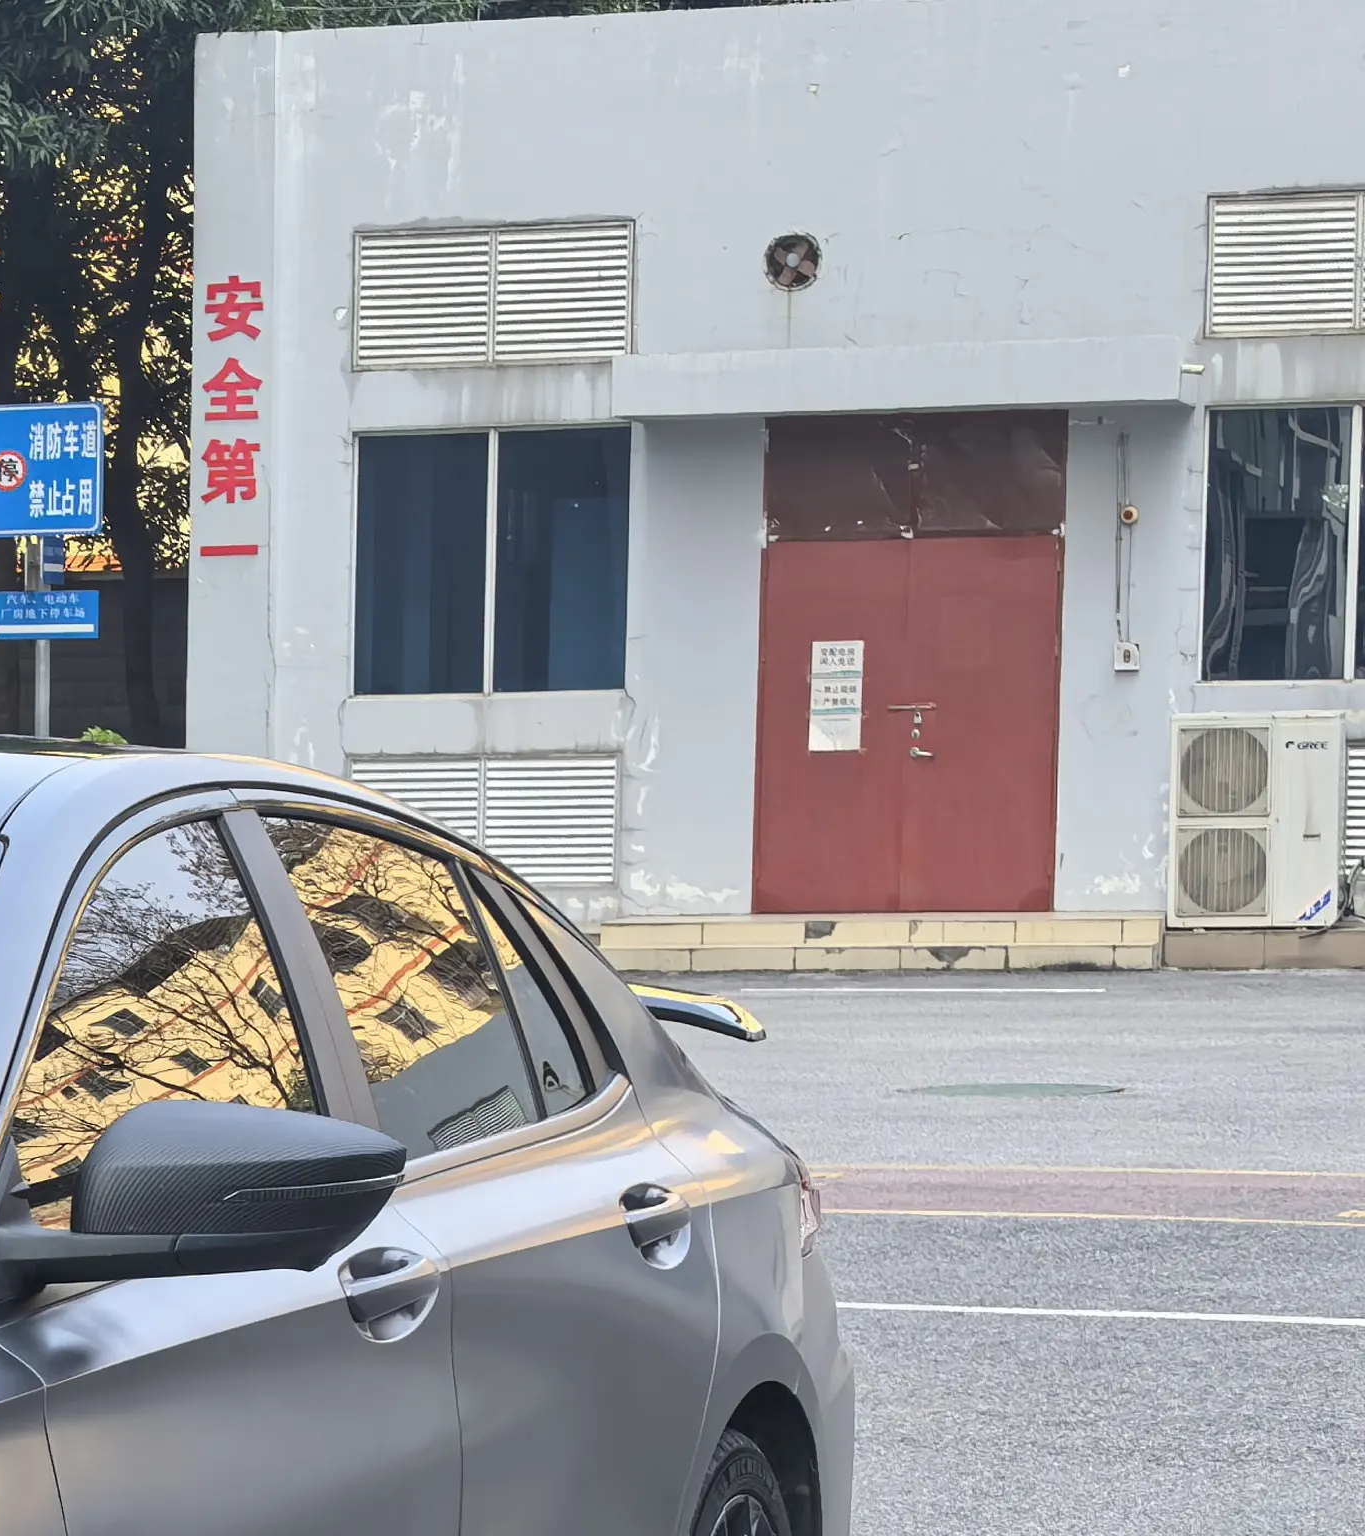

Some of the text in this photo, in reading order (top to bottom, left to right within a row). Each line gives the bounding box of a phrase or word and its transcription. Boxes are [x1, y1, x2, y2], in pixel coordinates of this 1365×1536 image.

[200, 275, 264, 557] 安全第一
[29, 421, 97, 460] 消防车道
[29, 478, 92, 518] 禁止占用
[0, 607, 86, 619] 厂房地下停车场
